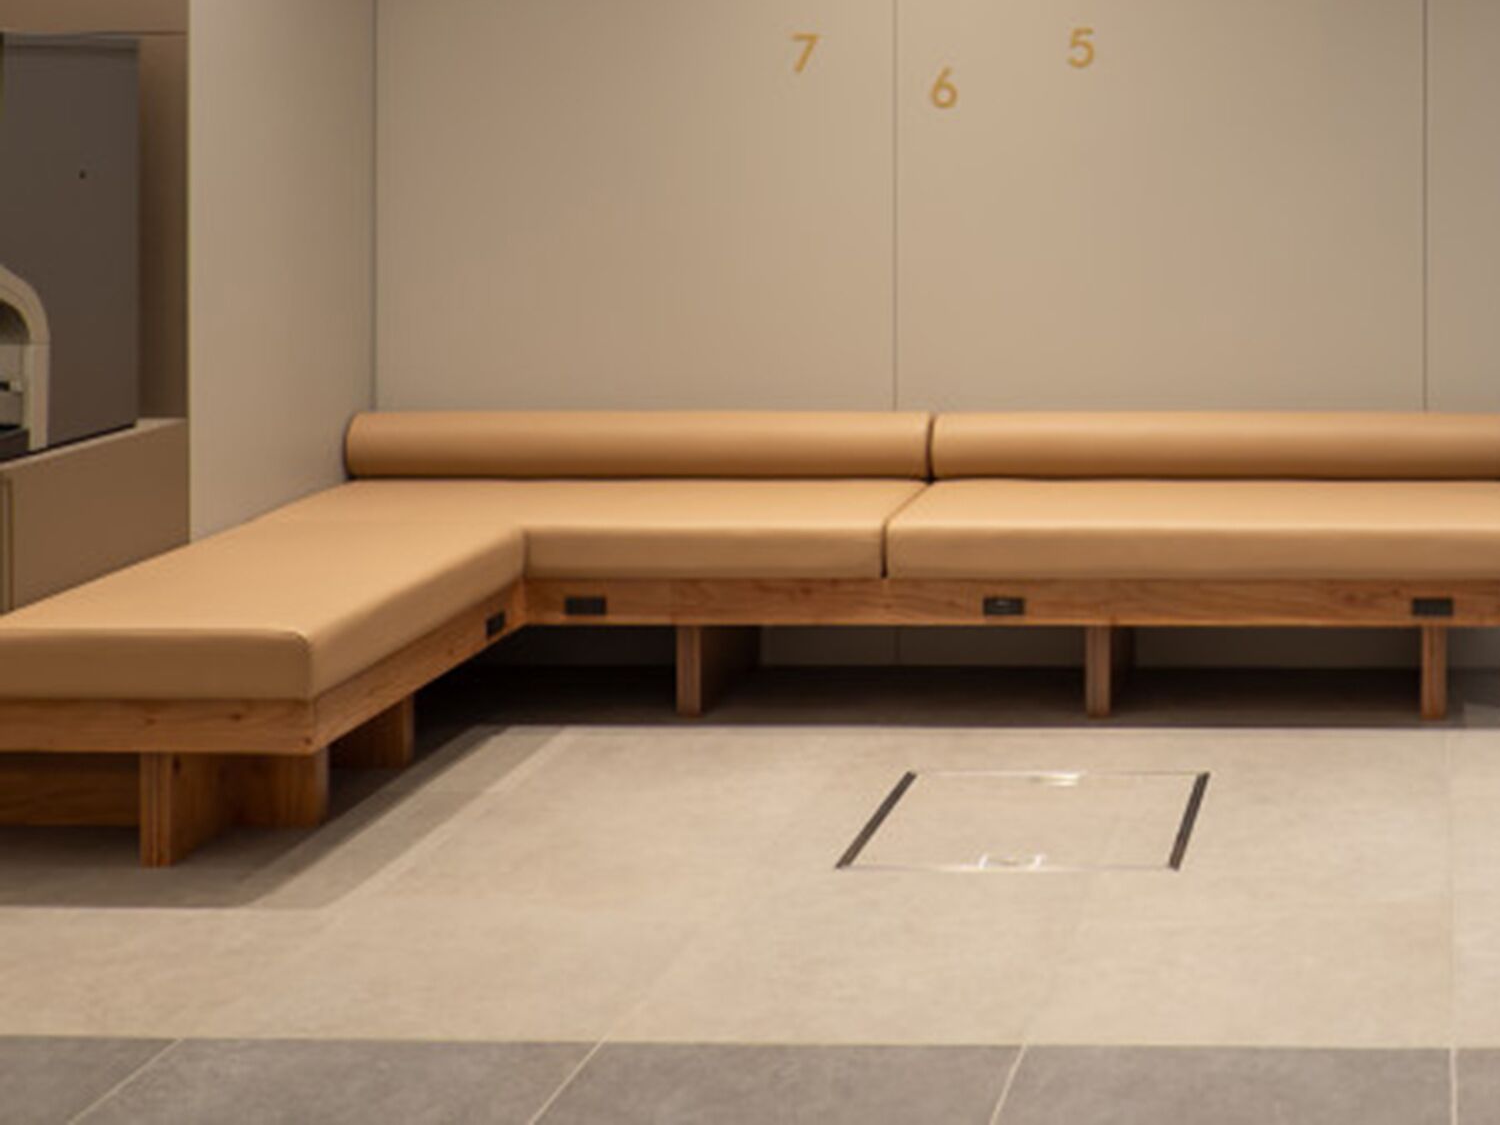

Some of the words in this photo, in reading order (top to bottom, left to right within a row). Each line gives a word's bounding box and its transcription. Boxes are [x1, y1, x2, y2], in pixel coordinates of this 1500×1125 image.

[791, 32, 820, 73] 7
[1068, 27, 1096, 68] 5
[930, 67, 959, 109] 6
